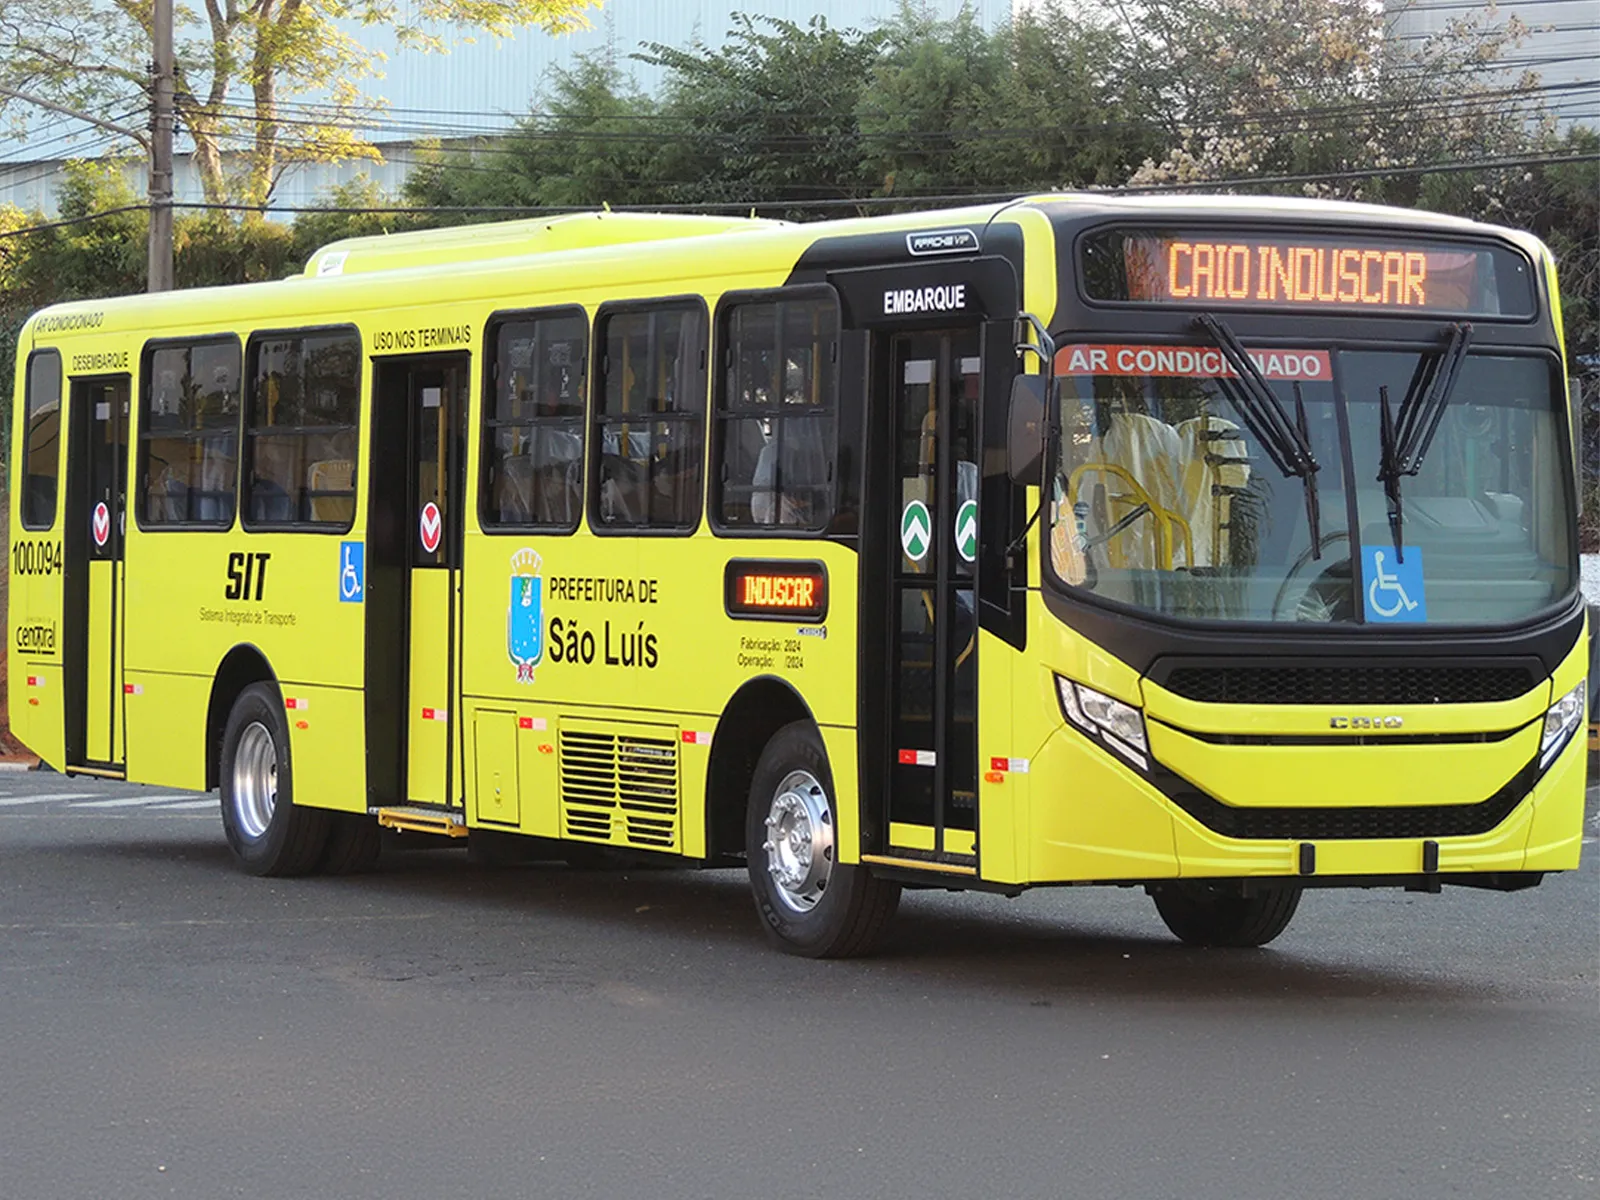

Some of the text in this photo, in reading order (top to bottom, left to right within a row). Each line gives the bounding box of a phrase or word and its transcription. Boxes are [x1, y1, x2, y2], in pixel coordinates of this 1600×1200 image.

[954, 234, 969, 245] VIP
[1168, 242, 1426, 305] CAIO INDUSCAR
[884, 284, 965, 314] EMBARQUE
[373, 324, 471, 349] USO NOS TERMINAIS
[73, 351, 128, 371] DESEMBARQUE
[1068, 349, 1108, 371] AR
[12, 540, 61, 575] 100.094
[225, 552, 270, 600] SIT
[549, 576, 657, 603] PREFEITURA DE
[744, 575, 813, 606] INDUSCAR
[199, 606, 222, 622] Sistema
[254, 610, 261, 623] de
[549, 616, 658, 668] São Luís
[784, 639, 801, 652] 2024
